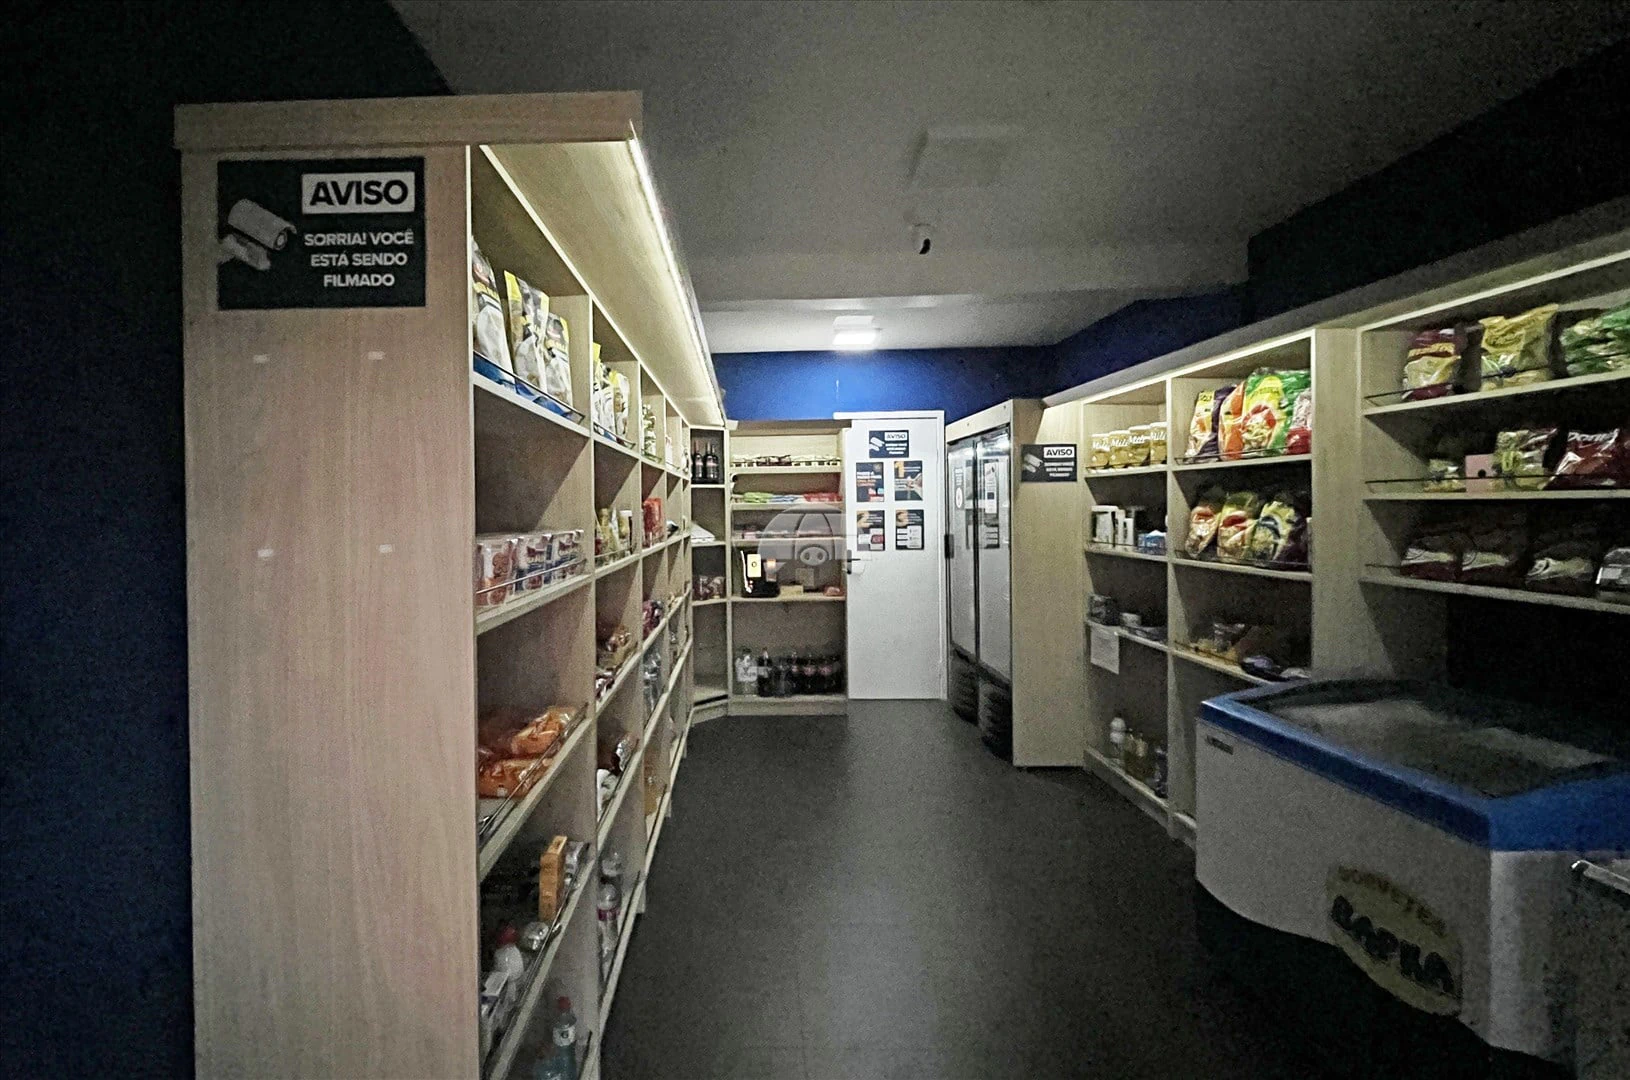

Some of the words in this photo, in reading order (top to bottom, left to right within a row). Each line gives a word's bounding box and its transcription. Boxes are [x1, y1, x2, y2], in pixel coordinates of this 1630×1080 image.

[309, 180, 408, 206] AVISO
[304, 232, 367, 247] SORRIA!
[369, 228, 414, 246] VOCÊ
[310, 250, 349, 267] ESTÁ
[352, 252, 408, 266] SENDO
[323, 273, 395, 287] FILMADO
[1046, 448, 1073, 456] AVISO
